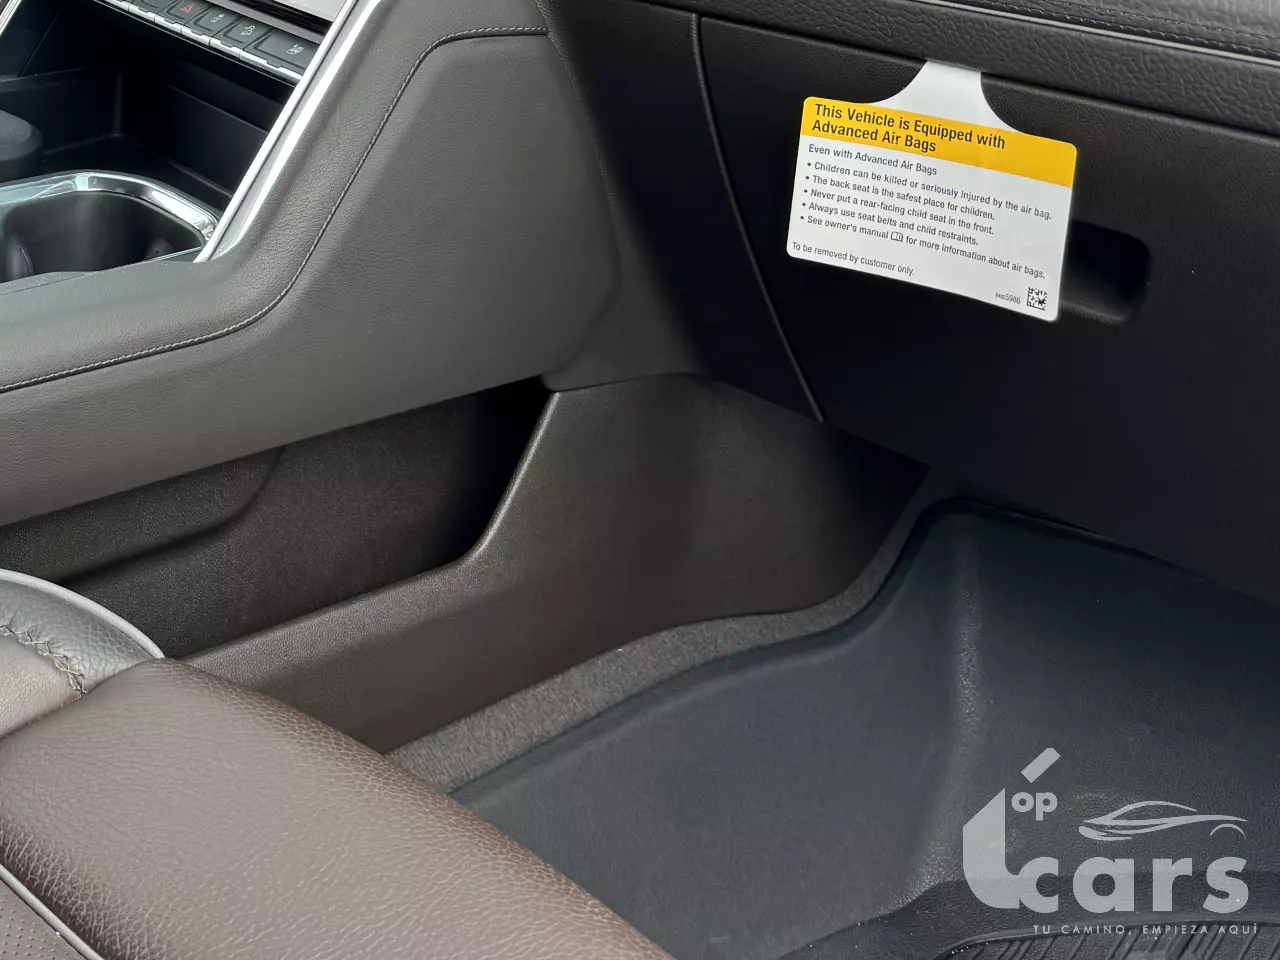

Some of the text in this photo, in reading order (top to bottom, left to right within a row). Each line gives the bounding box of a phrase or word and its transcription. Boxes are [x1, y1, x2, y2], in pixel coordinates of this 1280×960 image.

[812, 120, 936, 152] Advanced Air Bags
[815, 104, 1005, 149] This Vehicle is Equipped with
[809, 144, 937, 176] Even with Advanced Air Bags
[810, 189, 835, 201] Never
[837, 194, 850, 204] put
[860, 197, 905, 216] rear-facing
[907, 207, 927, 219] child
[929, 213, 946, 224] seat
[949, 216, 955, 225] in
[958, 218, 970, 229] the
[973, 222, 994, 234] front.
[813, 175, 995, 220] The back seat is the safest place for children.
[814, 162, 1052, 220] Children can be killed or seriously injured by the air bag.
[809, 202, 978, 246] Always use seat belts and child restraints.
[792, 242, 915, 276] To be removed by customer only.
[807, 215, 1045, 279] See owner's manual for more information about air bags.
